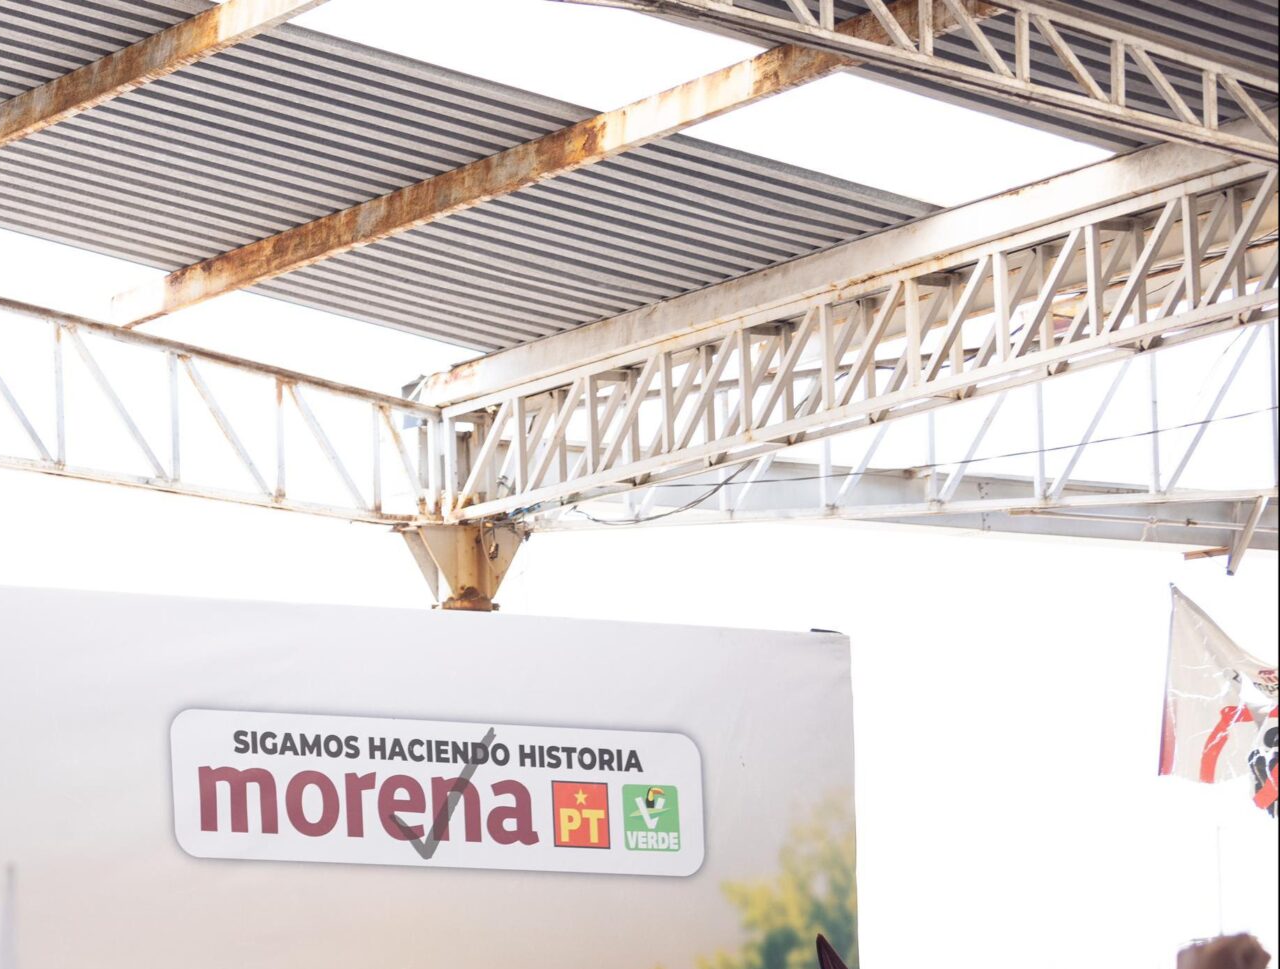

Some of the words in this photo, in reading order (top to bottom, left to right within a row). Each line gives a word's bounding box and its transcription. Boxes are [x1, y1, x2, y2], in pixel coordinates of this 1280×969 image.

[232, 729, 361, 760] SIGAMOS
[368, 735, 511, 767] HACIENDO
[518, 744, 644, 773] HISTORIA
[196, 764, 540, 847] morena
[559, 807, 606, 844] PT
[626, 830, 679, 850] VERDE
